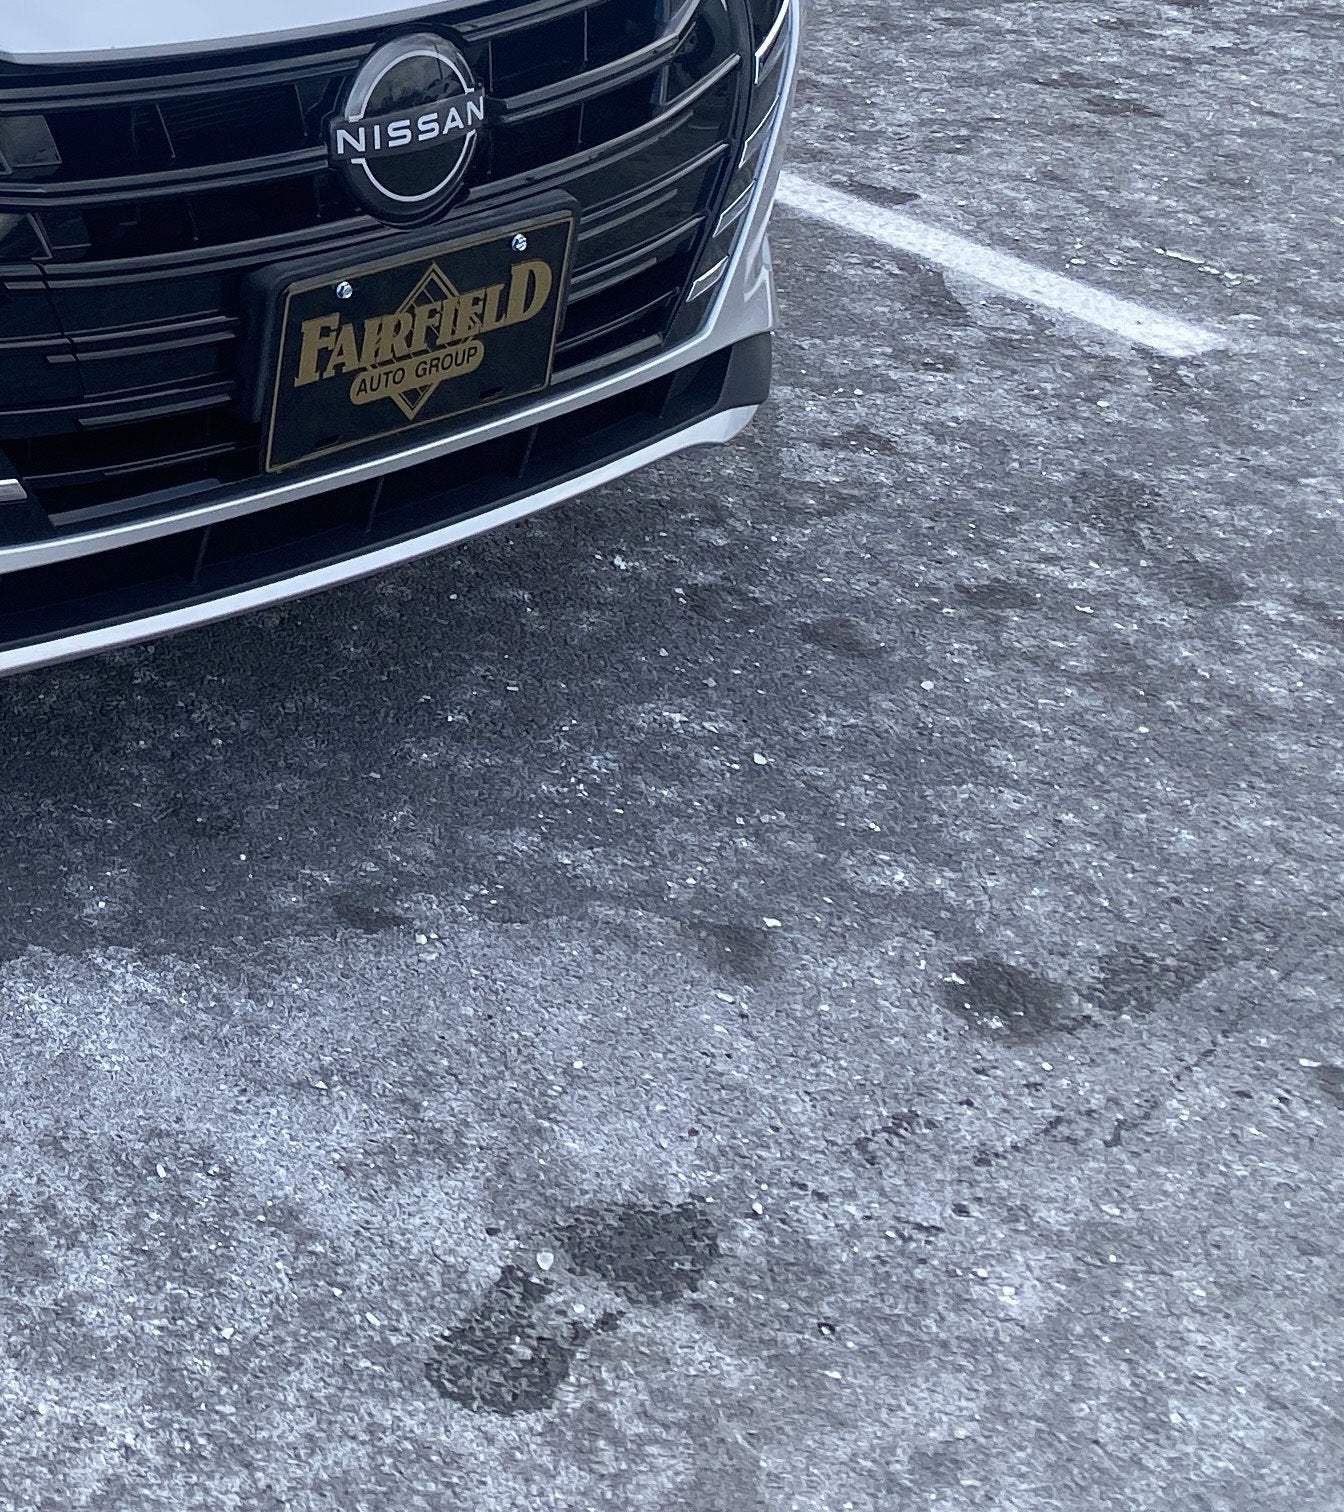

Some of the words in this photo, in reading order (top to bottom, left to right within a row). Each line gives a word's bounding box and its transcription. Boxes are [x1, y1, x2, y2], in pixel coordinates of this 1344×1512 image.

[336, 94, 486, 156] NISSAN
[293, 258, 553, 388] FAIRFIELD
[355, 366, 406, 397] AUTO
[414, 345, 480, 379] GROUP
